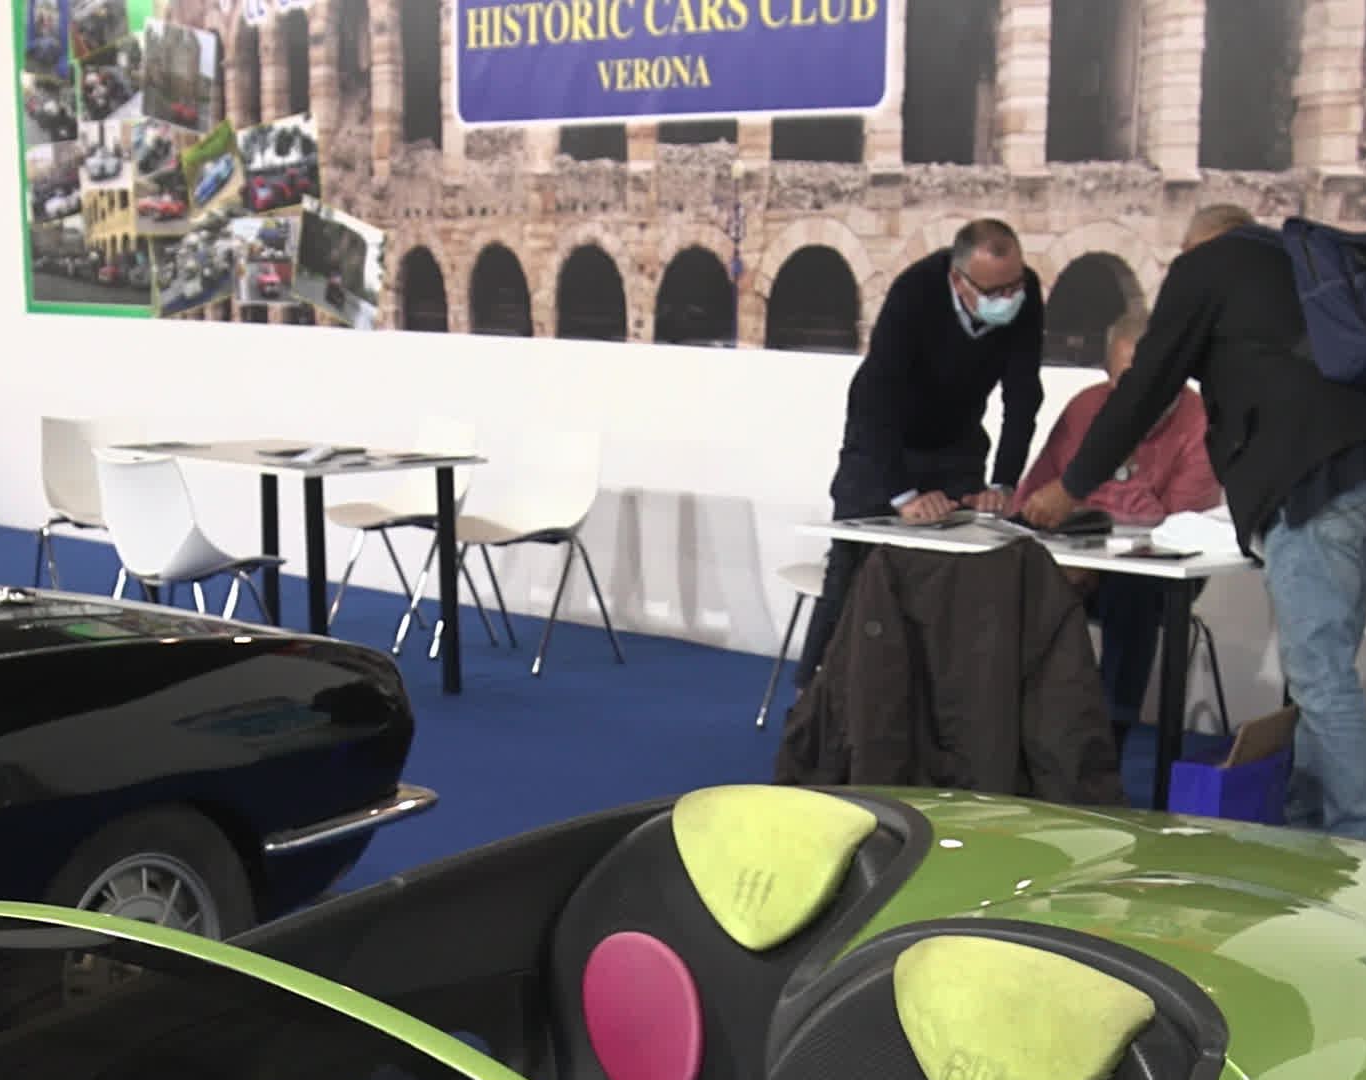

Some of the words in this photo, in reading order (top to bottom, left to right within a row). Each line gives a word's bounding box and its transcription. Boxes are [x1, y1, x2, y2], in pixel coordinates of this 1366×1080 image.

[467, 0, 634, 49] HISTORIC
[643, 0, 749, 37] CARS
[759, 0, 878, 28] CLUB
[597, 56, 712, 91] VERONA
